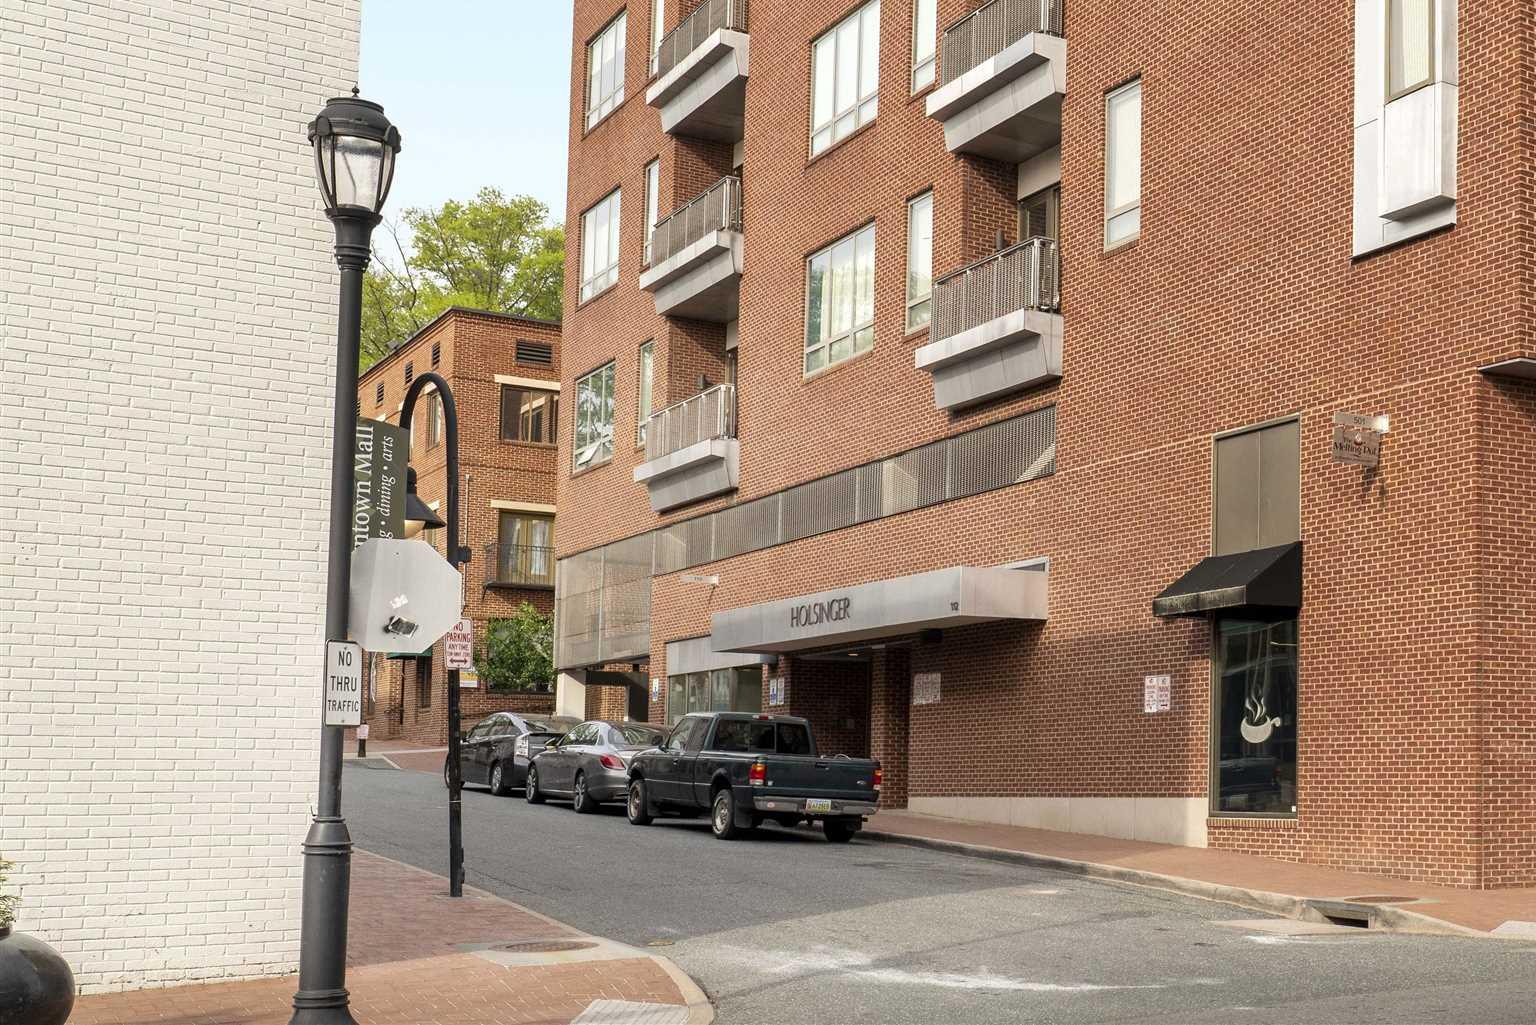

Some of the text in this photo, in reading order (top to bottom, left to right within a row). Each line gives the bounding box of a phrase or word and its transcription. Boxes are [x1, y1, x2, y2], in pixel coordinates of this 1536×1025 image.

[382, 436, 394, 461] arts
[352, 426, 374, 550] ntown Mall
[376, 475, 395, 516] dining
[790, 597, 851, 627] HOLSINGER
[453, 622, 464, 632] NO
[446, 632, 471, 643] PARKING
[448, 643, 469, 651] ANYTIME
[338, 651, 352, 666] NO
[330, 675, 357, 692] THRU
[327, 699, 359, 712] TRAFFIC
